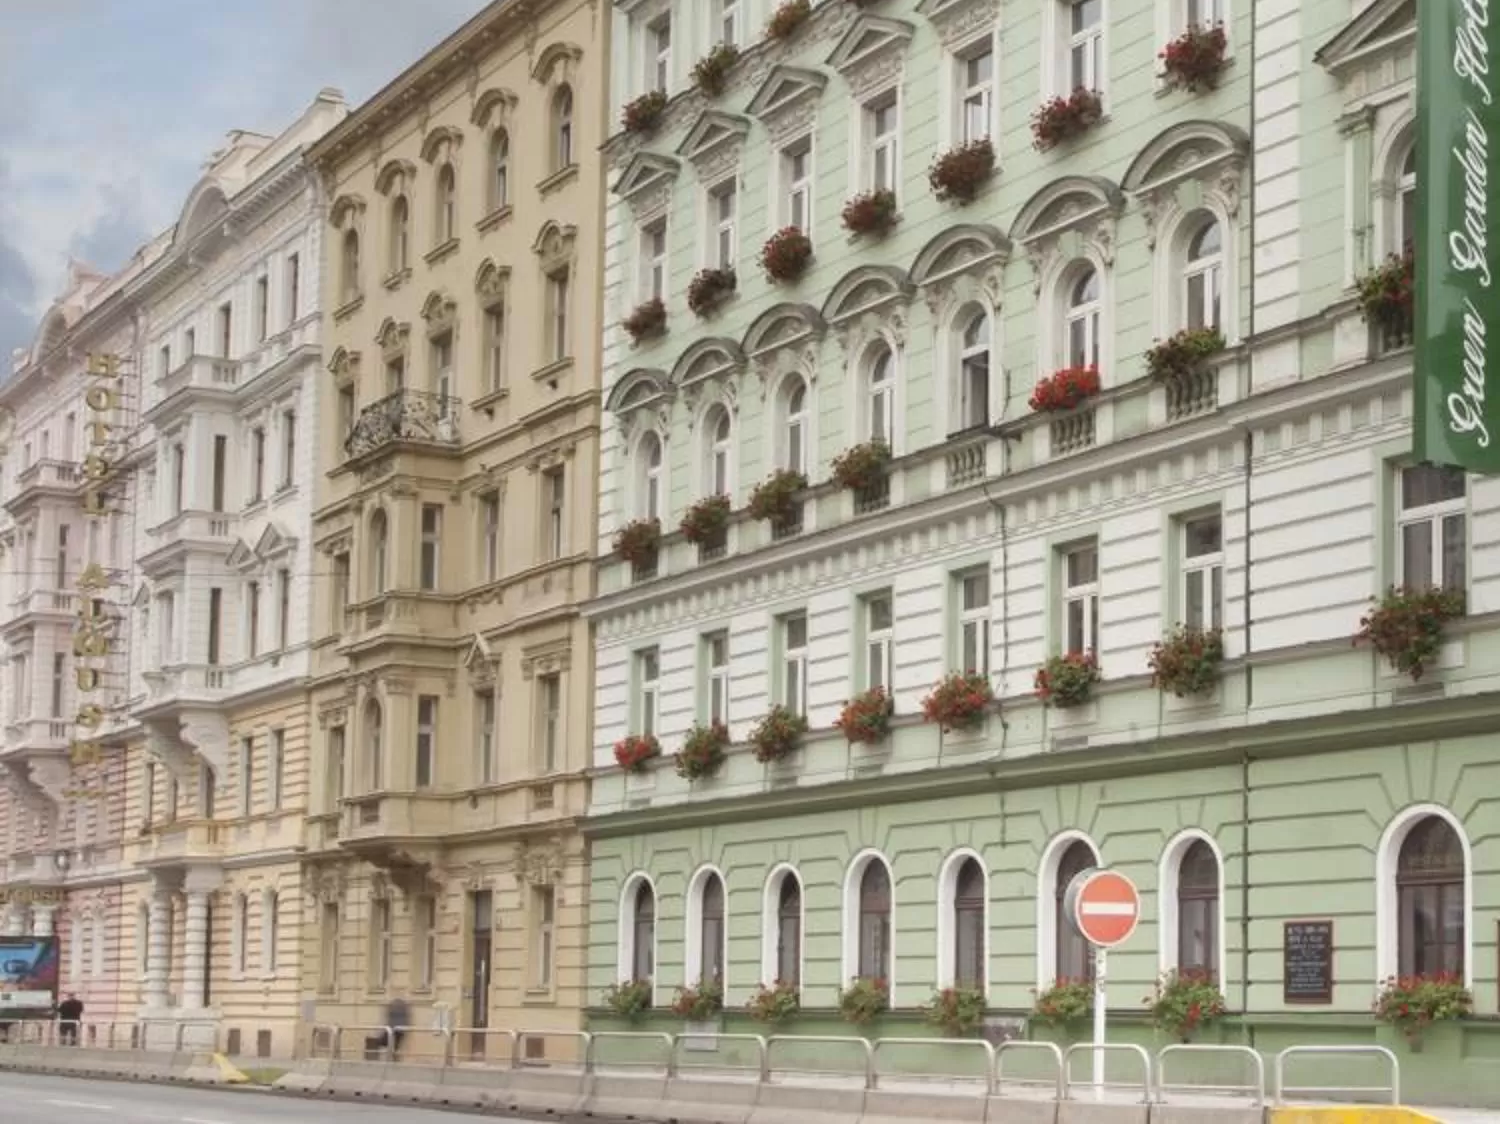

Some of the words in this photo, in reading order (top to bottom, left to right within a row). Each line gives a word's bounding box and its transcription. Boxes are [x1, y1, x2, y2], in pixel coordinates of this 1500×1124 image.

[1449, 106, 1491, 287] Garden
[82, 353, 119, 516] HOTEL
[1447, 296, 1489, 448] Green
